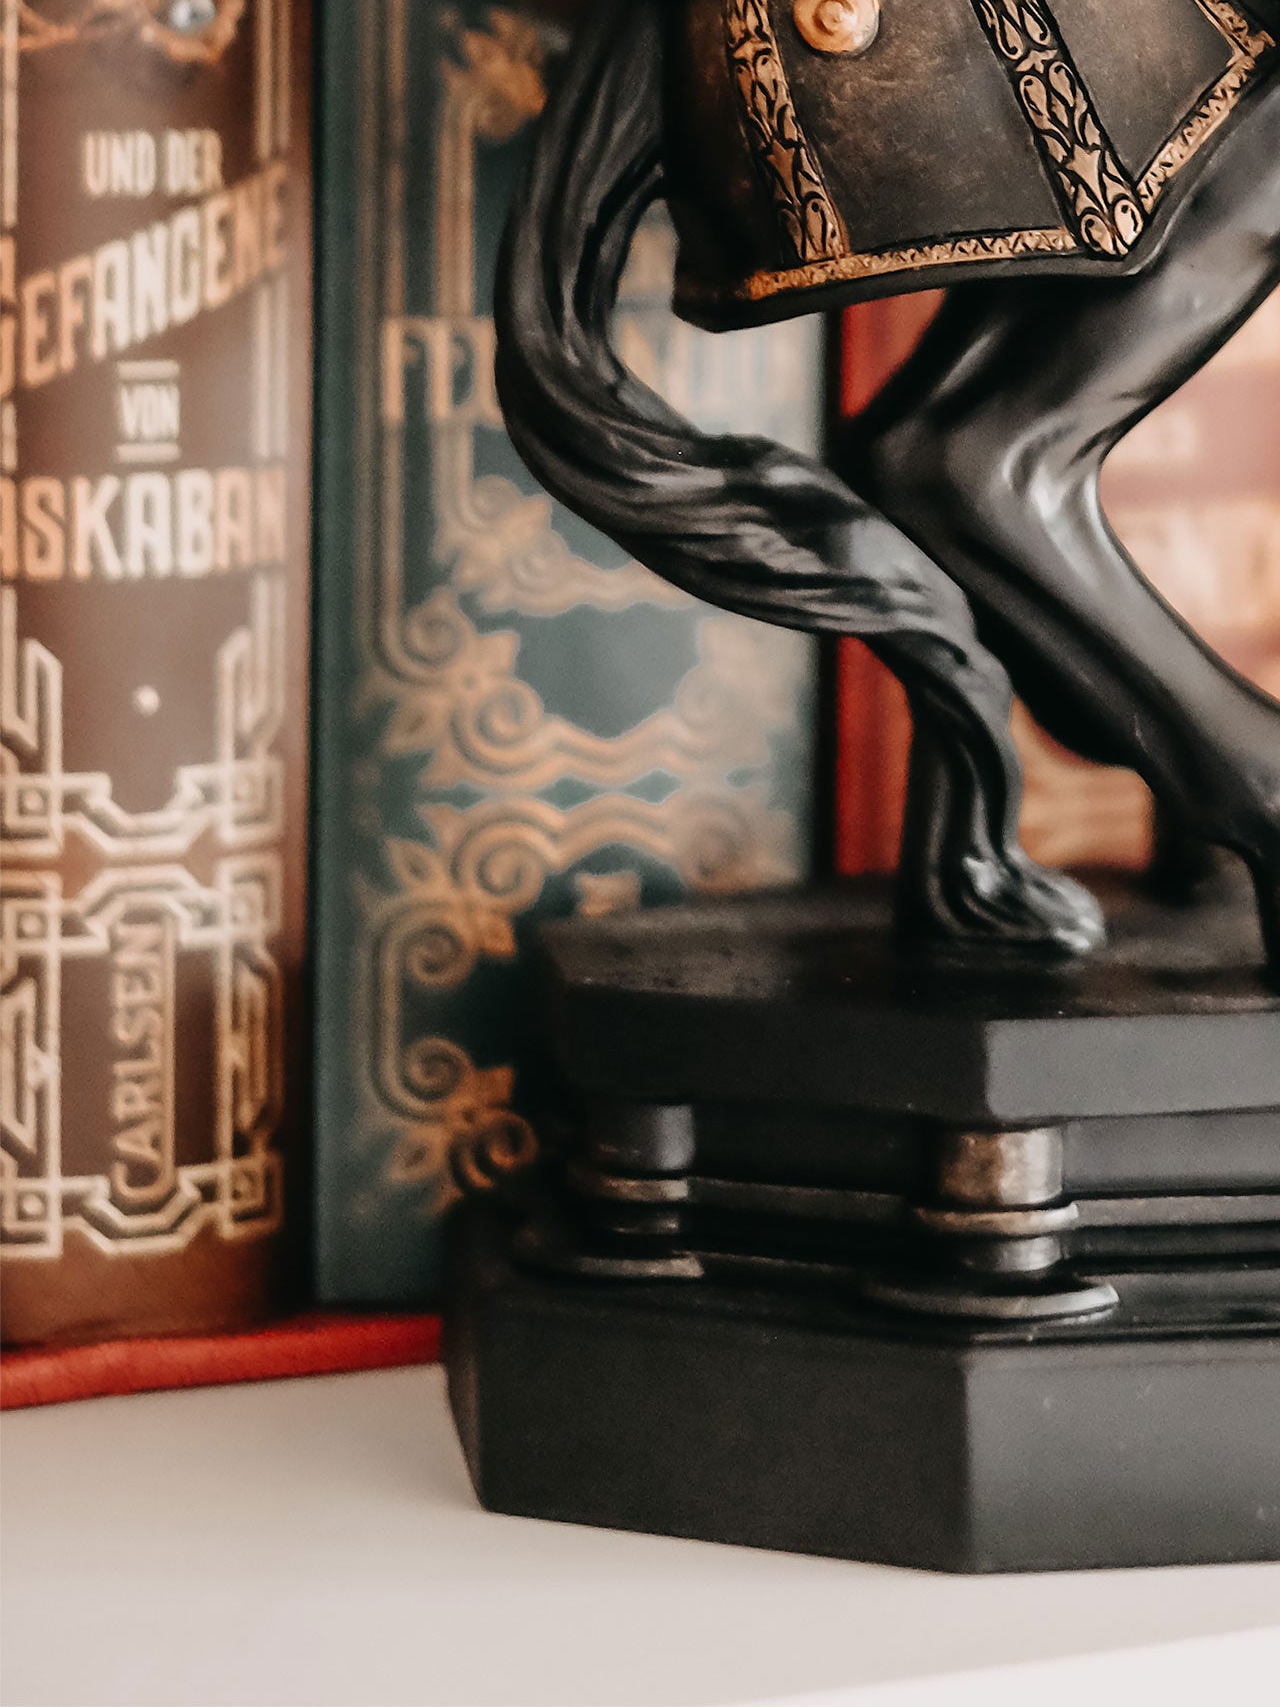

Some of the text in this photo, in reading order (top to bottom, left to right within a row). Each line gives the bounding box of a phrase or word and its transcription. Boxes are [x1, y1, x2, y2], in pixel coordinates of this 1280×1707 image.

[82, 127, 226, 197] UND DER
[118, 381, 182, 443] VON
[110, 917, 176, 1203] CARLSEN
